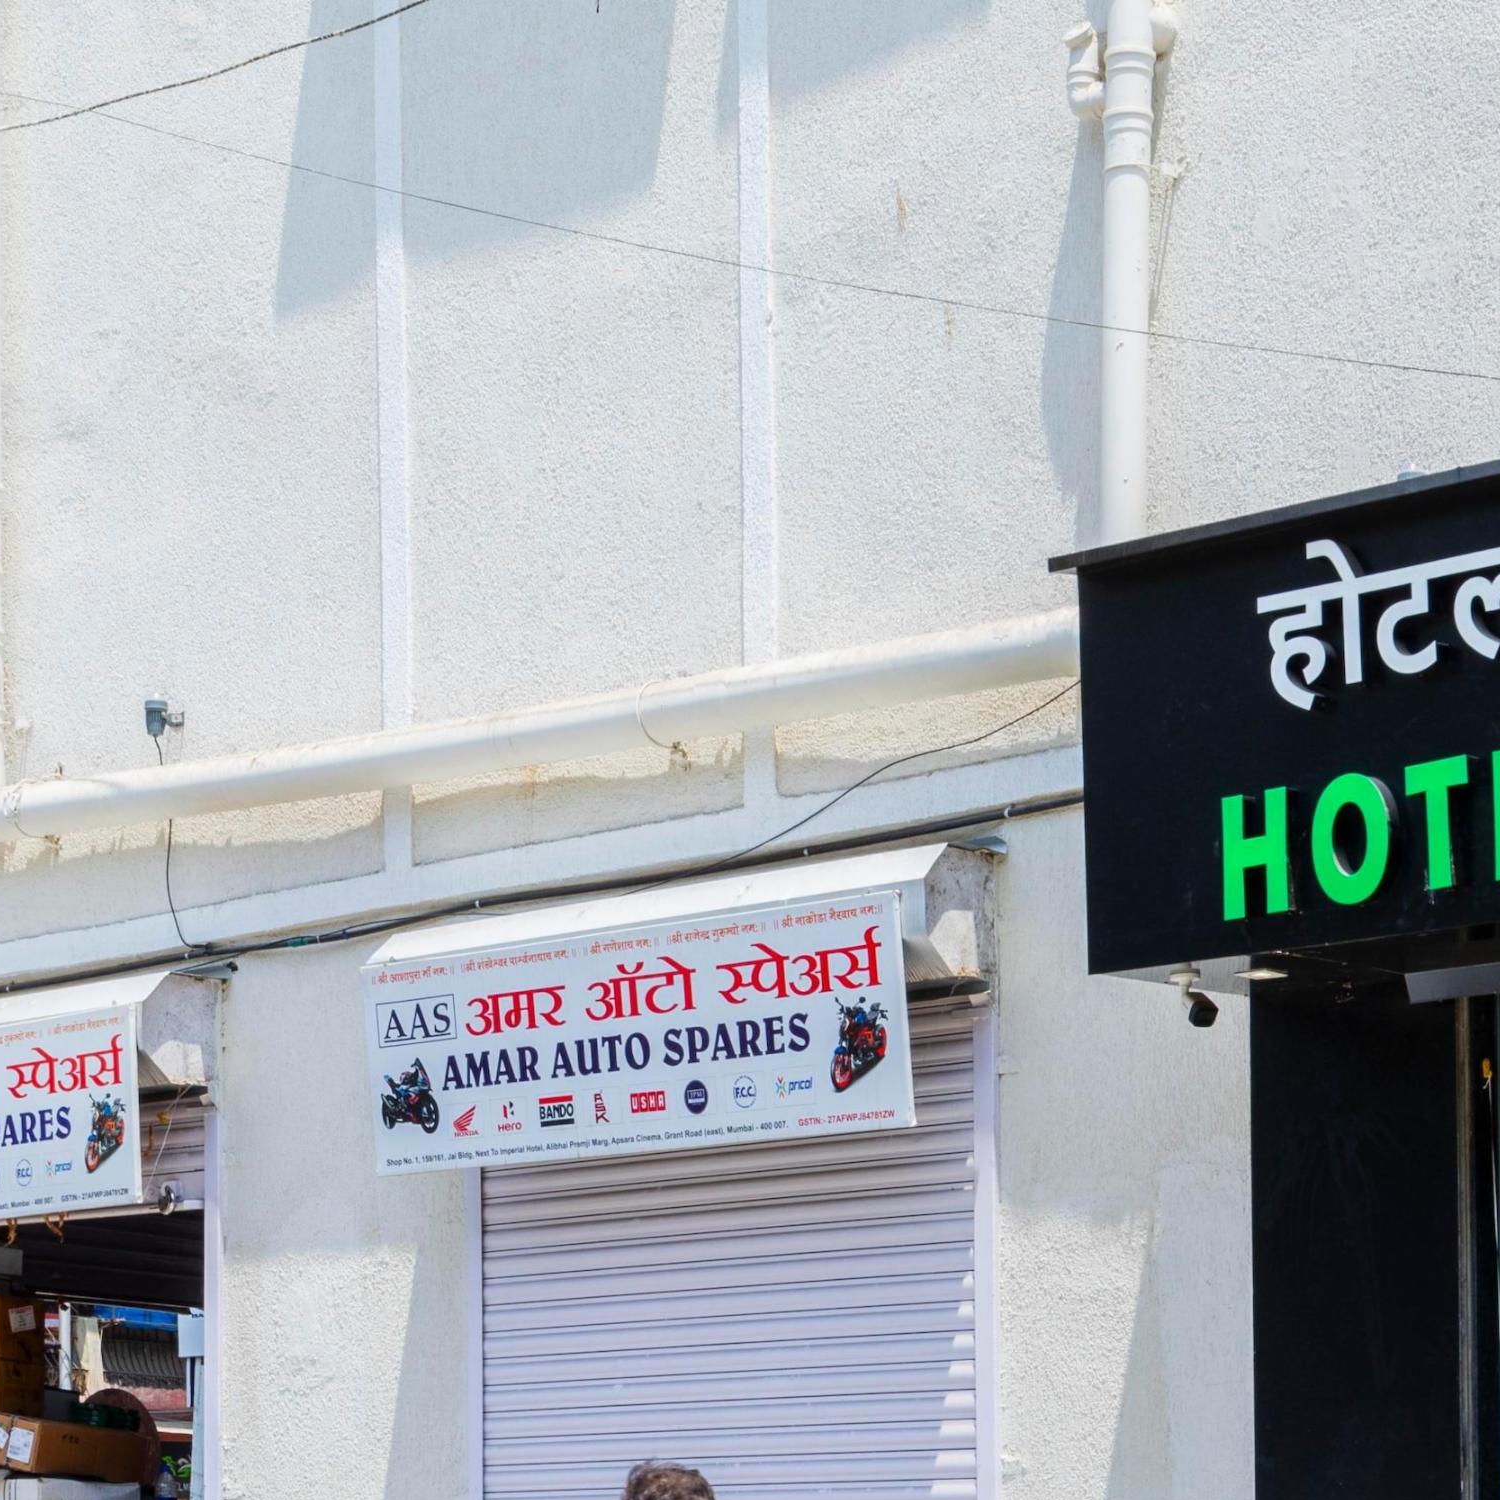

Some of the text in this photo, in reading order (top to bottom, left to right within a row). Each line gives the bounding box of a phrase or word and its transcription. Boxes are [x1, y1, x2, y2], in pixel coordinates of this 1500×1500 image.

[465, 925, 882, 1036] अमर ऑटो स्पेअर्स
[383, 1002, 451, 1041] AAS
[6, 1033, 123, 1099] स्पेअर्स
[443, 1014, 811, 1091] AMAR AUTO SPARES
[539, 1103, 574, 1121] BANDO
[630, 1092, 666, 1113] USHA
[386, 1156, 402, 1166] Shop
[475, 1148, 490, 1158] Next
[500, 1144, 525, 1156] Imperial
[611, 1133, 635, 1146] Apsara
[664, 1128, 684, 1140] Grant
[685, 1126, 702, 1138] Road
[726, 1122, 754, 1134] Mumbai
